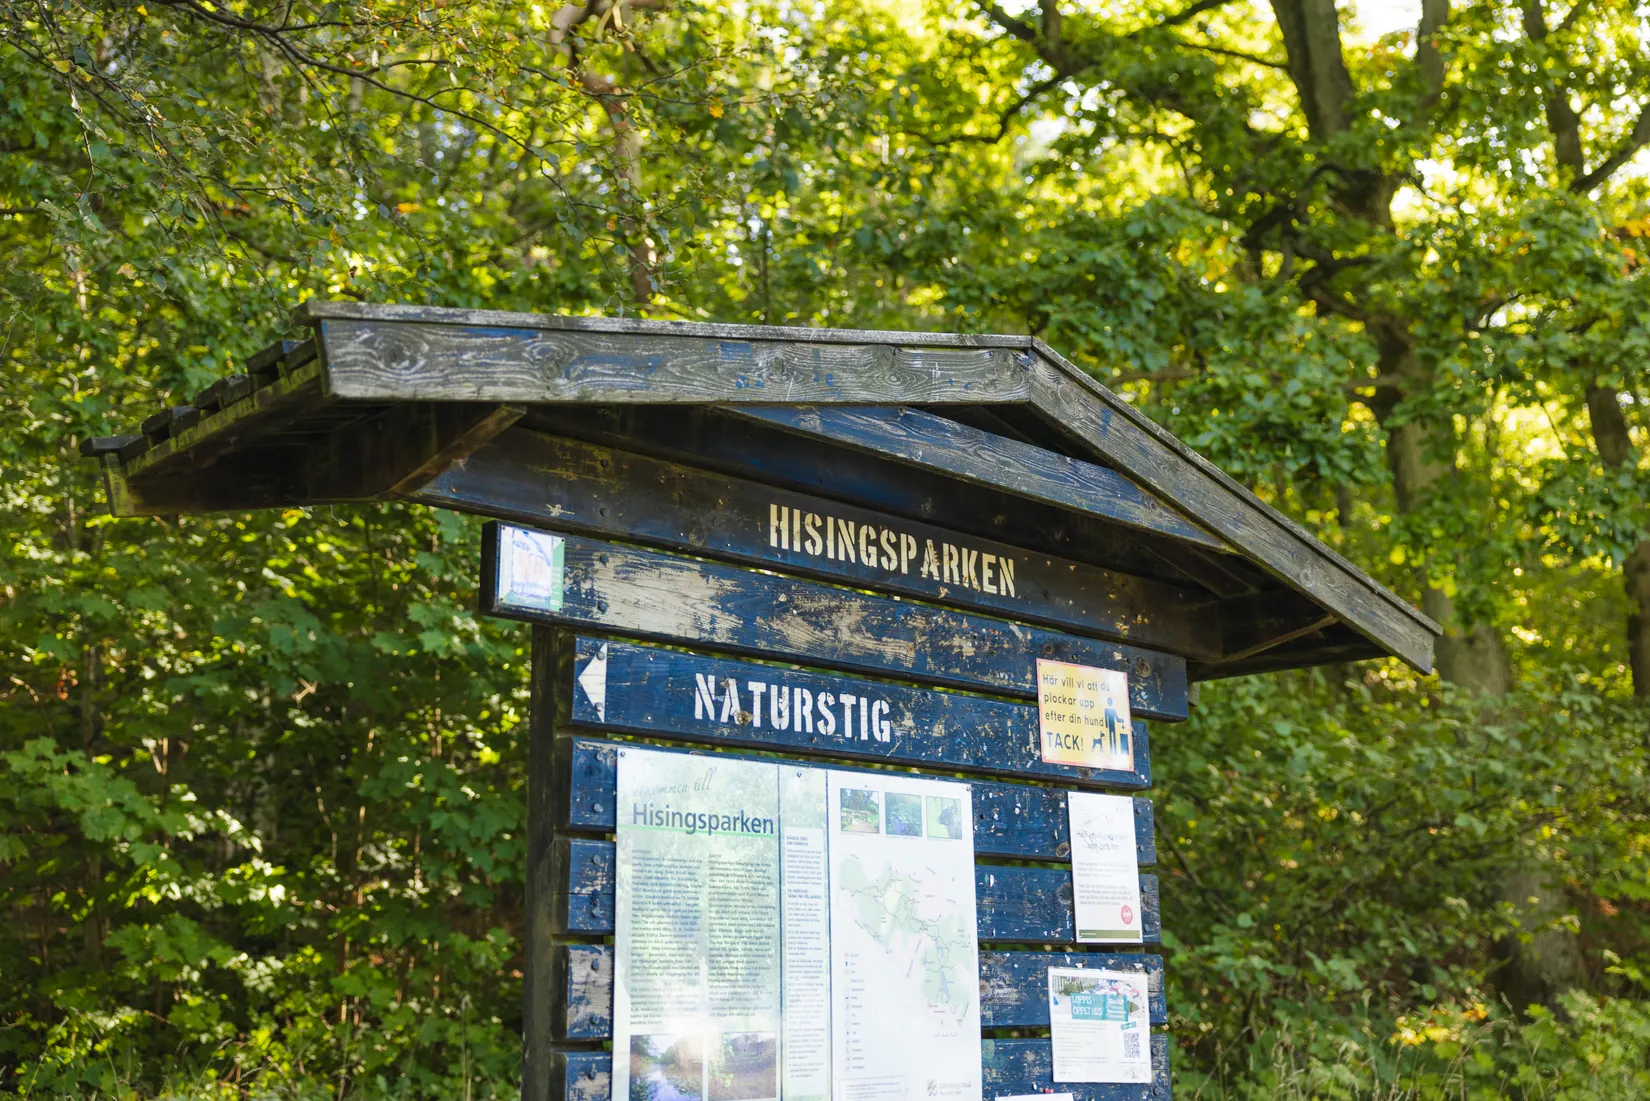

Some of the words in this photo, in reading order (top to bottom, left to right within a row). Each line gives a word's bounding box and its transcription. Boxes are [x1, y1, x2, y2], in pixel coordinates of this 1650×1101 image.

[769, 503, 1016, 598] HISINGSPARKEN
[1043, 673, 1058, 685] Här
[1061, 676, 1074, 688] vill
[1077, 679, 1084, 689] vi
[1087, 682, 1098, 692] att
[1101, 681, 1111, 692] du
[694, 673, 891, 743] NATURSTIG
[1044, 693, 1077, 706] plockar
[1080, 699, 1095, 710] upp
[1045, 710, 1066, 722] efter
[1069, 713, 1082, 724] din
[1085, 715, 1104, 727] hund
[1046, 731, 1084, 752] TACK!
[694, 766, 717, 791] till
[633, 802, 774, 836] Hisingsparken
[1091, 1007, 1103, 1016] HUS
